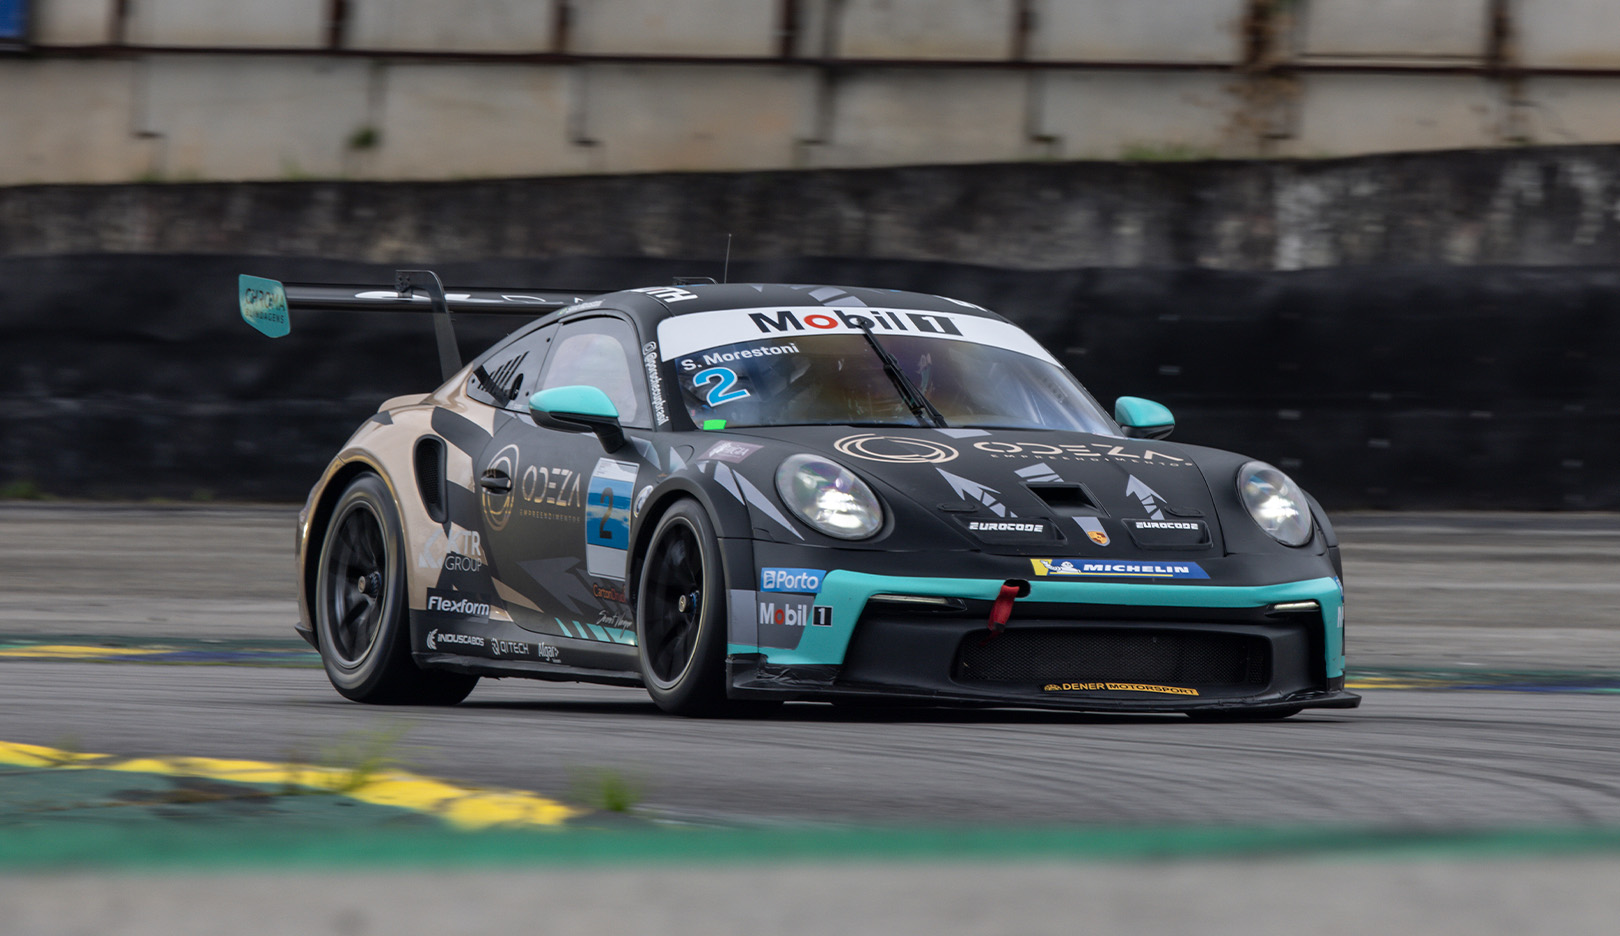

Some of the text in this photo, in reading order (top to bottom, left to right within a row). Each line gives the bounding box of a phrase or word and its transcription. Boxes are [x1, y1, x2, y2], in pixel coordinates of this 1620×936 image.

[748, 310, 908, 333] Mobil
[681, 342, 800, 371] S. Morestoni
[692, 366, 751, 408] 2
[973, 441, 1184, 462] ODEZA
[521, 464, 581, 508] ODEZA
[599, 487, 614, 539] 2
[969, 522, 1044, 533] EUROCODE
[1135, 521, 1199, 531] EUROCODE
[446, 529, 482, 556] KTR
[444, 556, 482, 572] GROUP
[1083, 564, 1189, 573] MICHELIN
[776, 570, 819, 590] Porto
[427, 596, 490, 616] Flexform
[760, 602, 807, 626] Mobil
[1062, 682, 1196, 695] DENER MOTORSPORT
